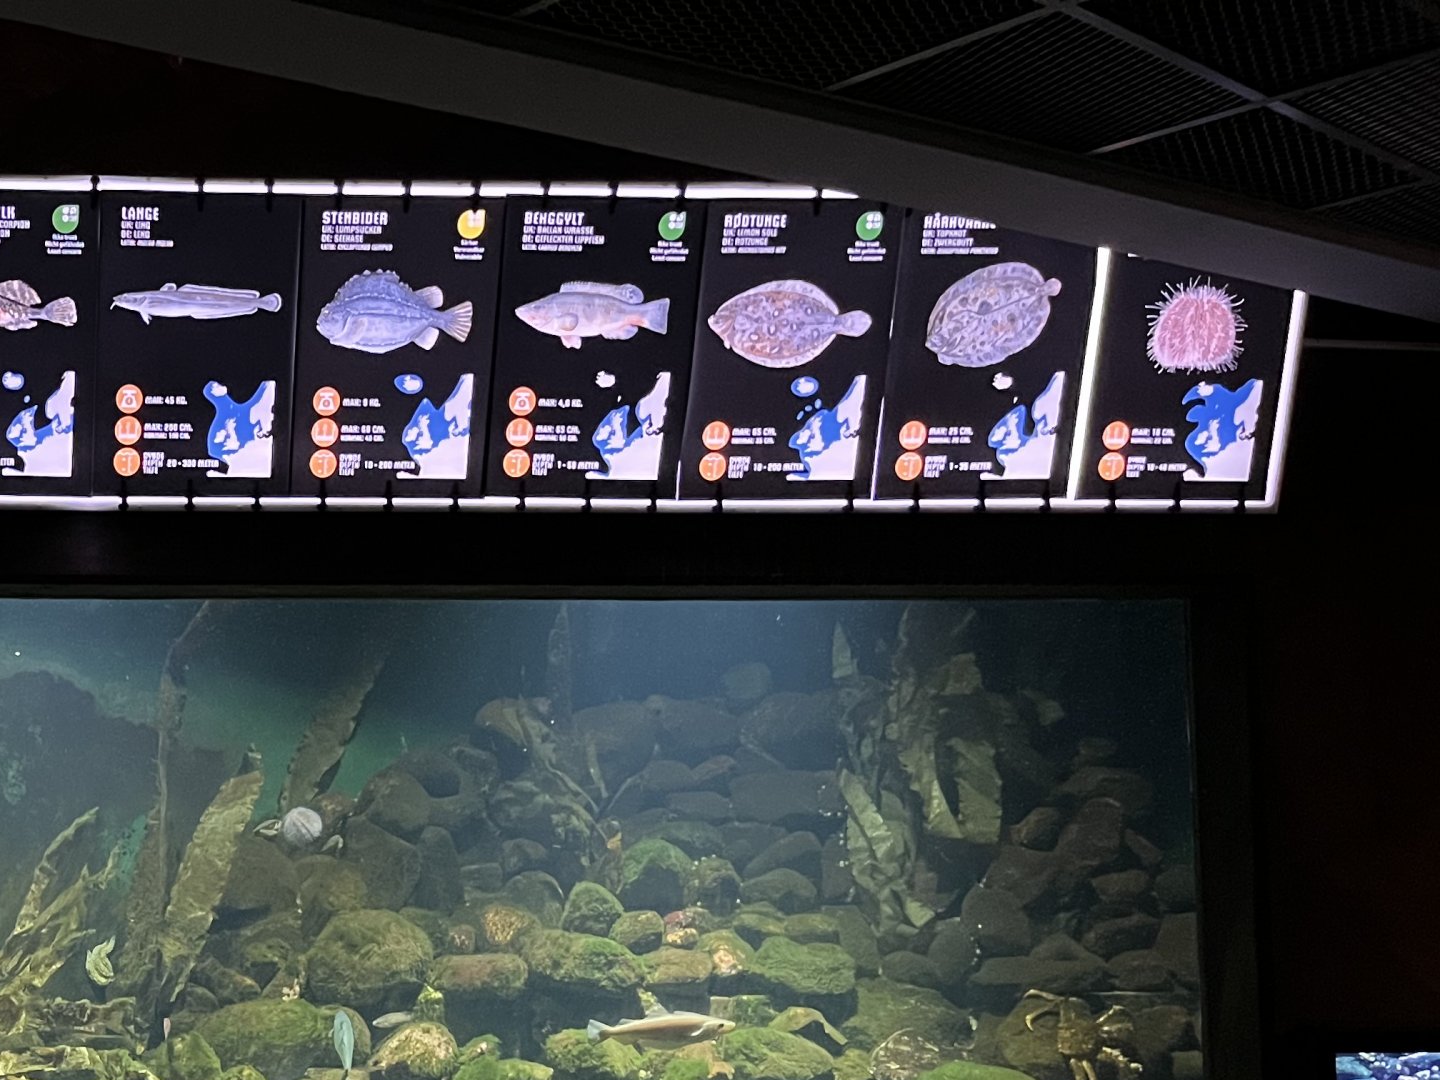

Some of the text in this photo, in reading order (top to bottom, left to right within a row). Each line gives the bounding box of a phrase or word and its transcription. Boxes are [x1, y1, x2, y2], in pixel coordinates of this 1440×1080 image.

[121, 207, 159, 220] LANGE
[322, 211, 388, 225] STENBIDER
[724, 213, 787, 228] RØDTUNGE
[121, 230, 133, 238] DE:
[321, 225, 382, 234] UK: LUMPSUCKER
[523, 226, 594, 235] UK: BALLAN WRASSE
[724, 229, 778, 237] UK: LEMON SOLE
[321, 234, 333, 243] DE:
[522, 235, 534, 244] DE:
